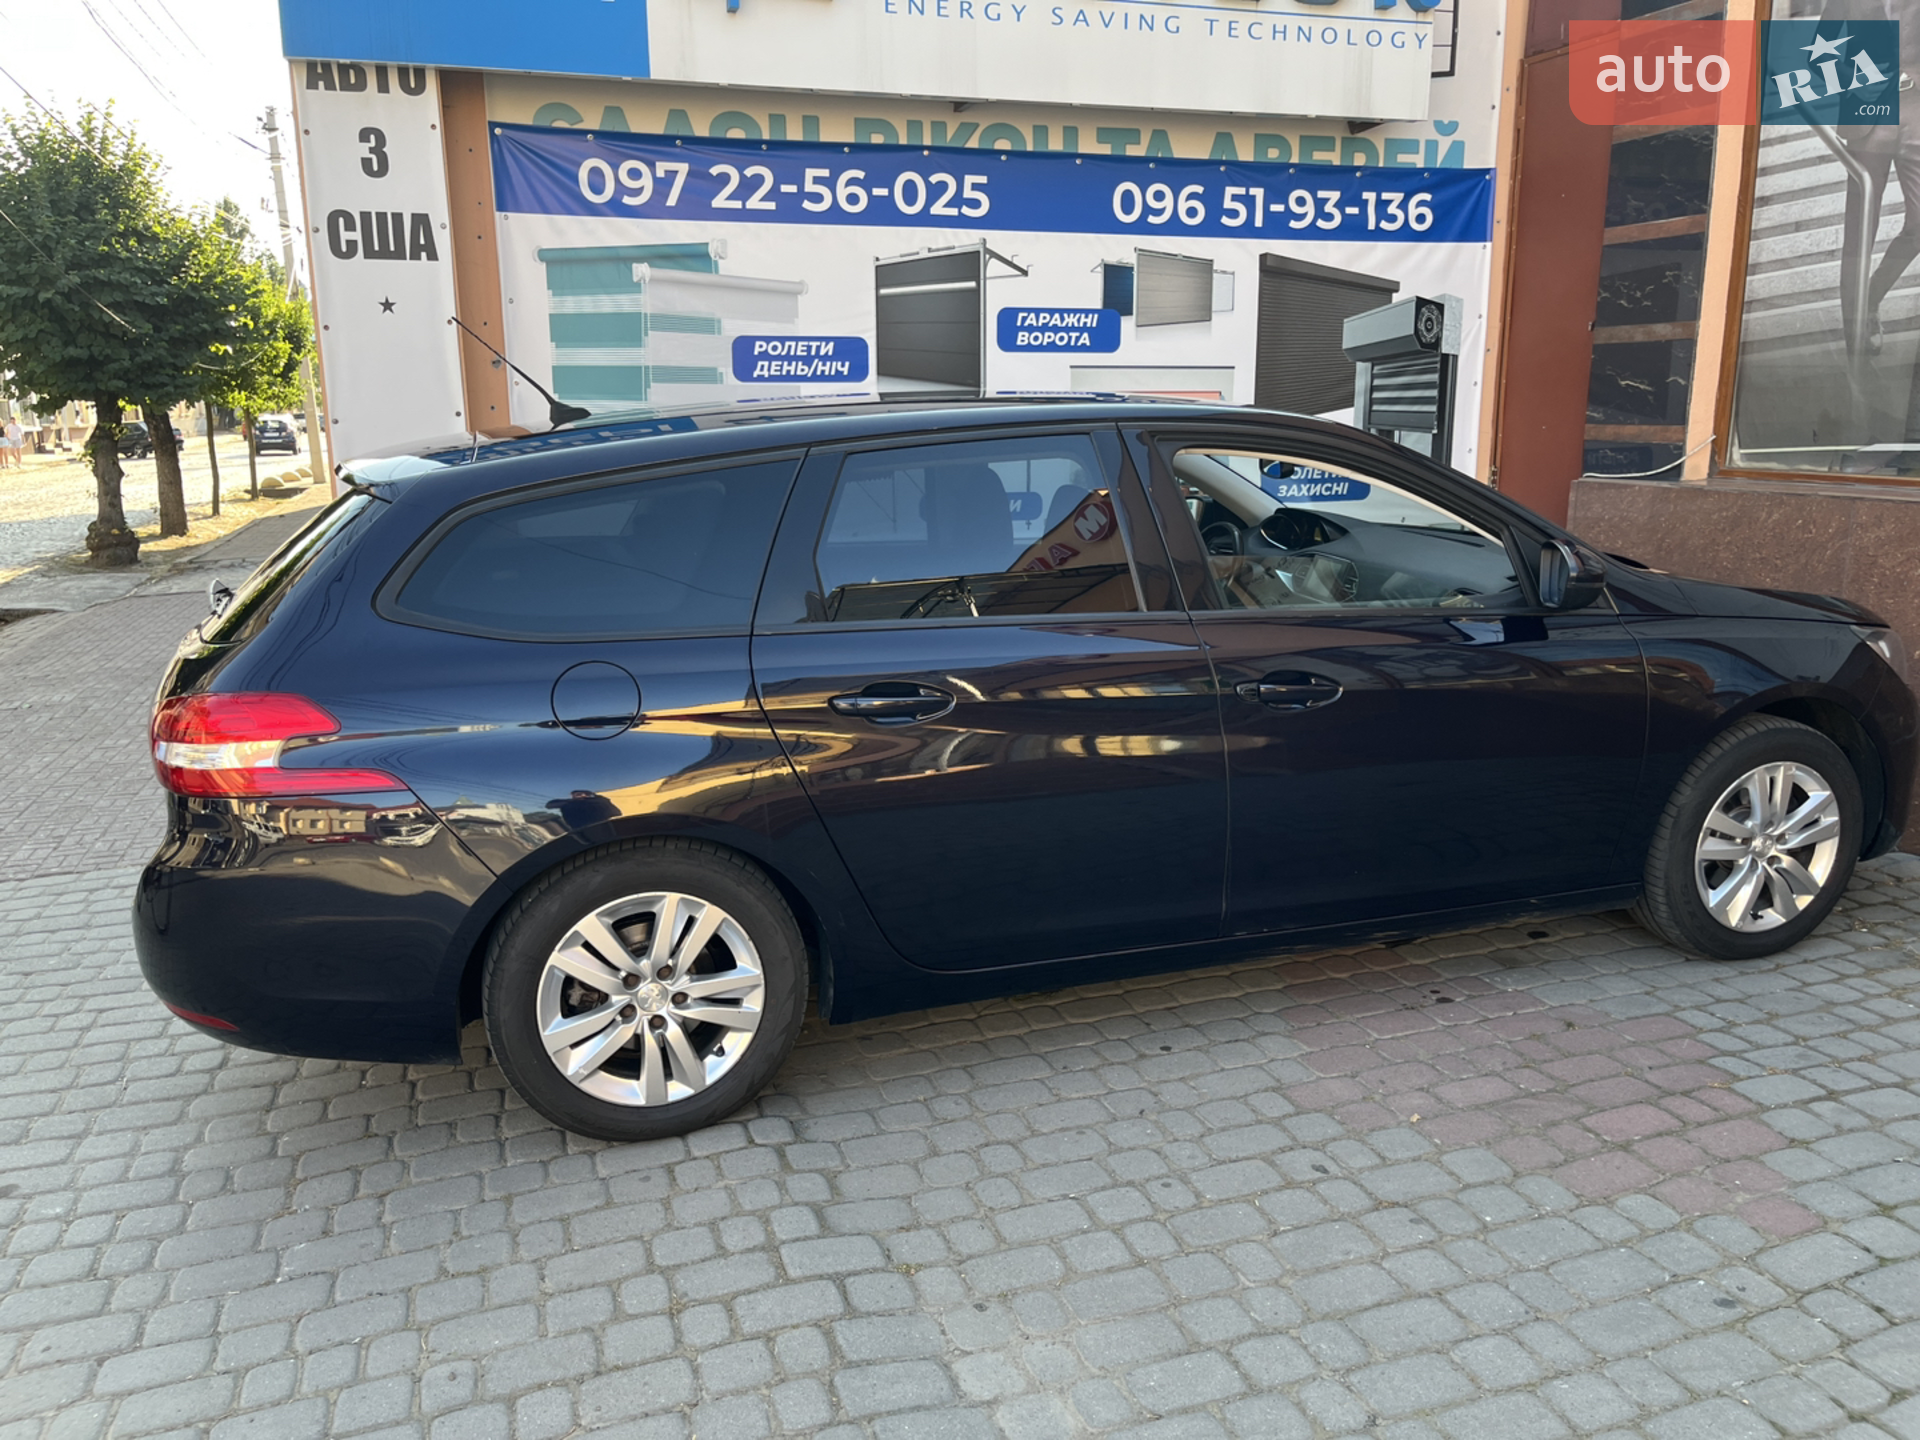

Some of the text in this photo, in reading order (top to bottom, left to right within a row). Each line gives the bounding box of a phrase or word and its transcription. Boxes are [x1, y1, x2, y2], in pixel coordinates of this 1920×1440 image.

[884, 0, 1428, 50] ENERGY SAVING TECHNOLOGY
[578, 158, 990, 218] 097 22-56-025
[1112, 181, 1433, 232] 096 51-93-136
[326, 208, 439, 261] США
[1016, 312, 1098, 328] ГАРАЖНІ
[754, 341, 834, 356] РОЛЕТИ
[1016, 331, 1091, 346] ВОРОТА
[753, 358, 850, 378] ДЕНЬ/НІЧ
[1277, 482, 1349, 497] ЗАХИСНІ
